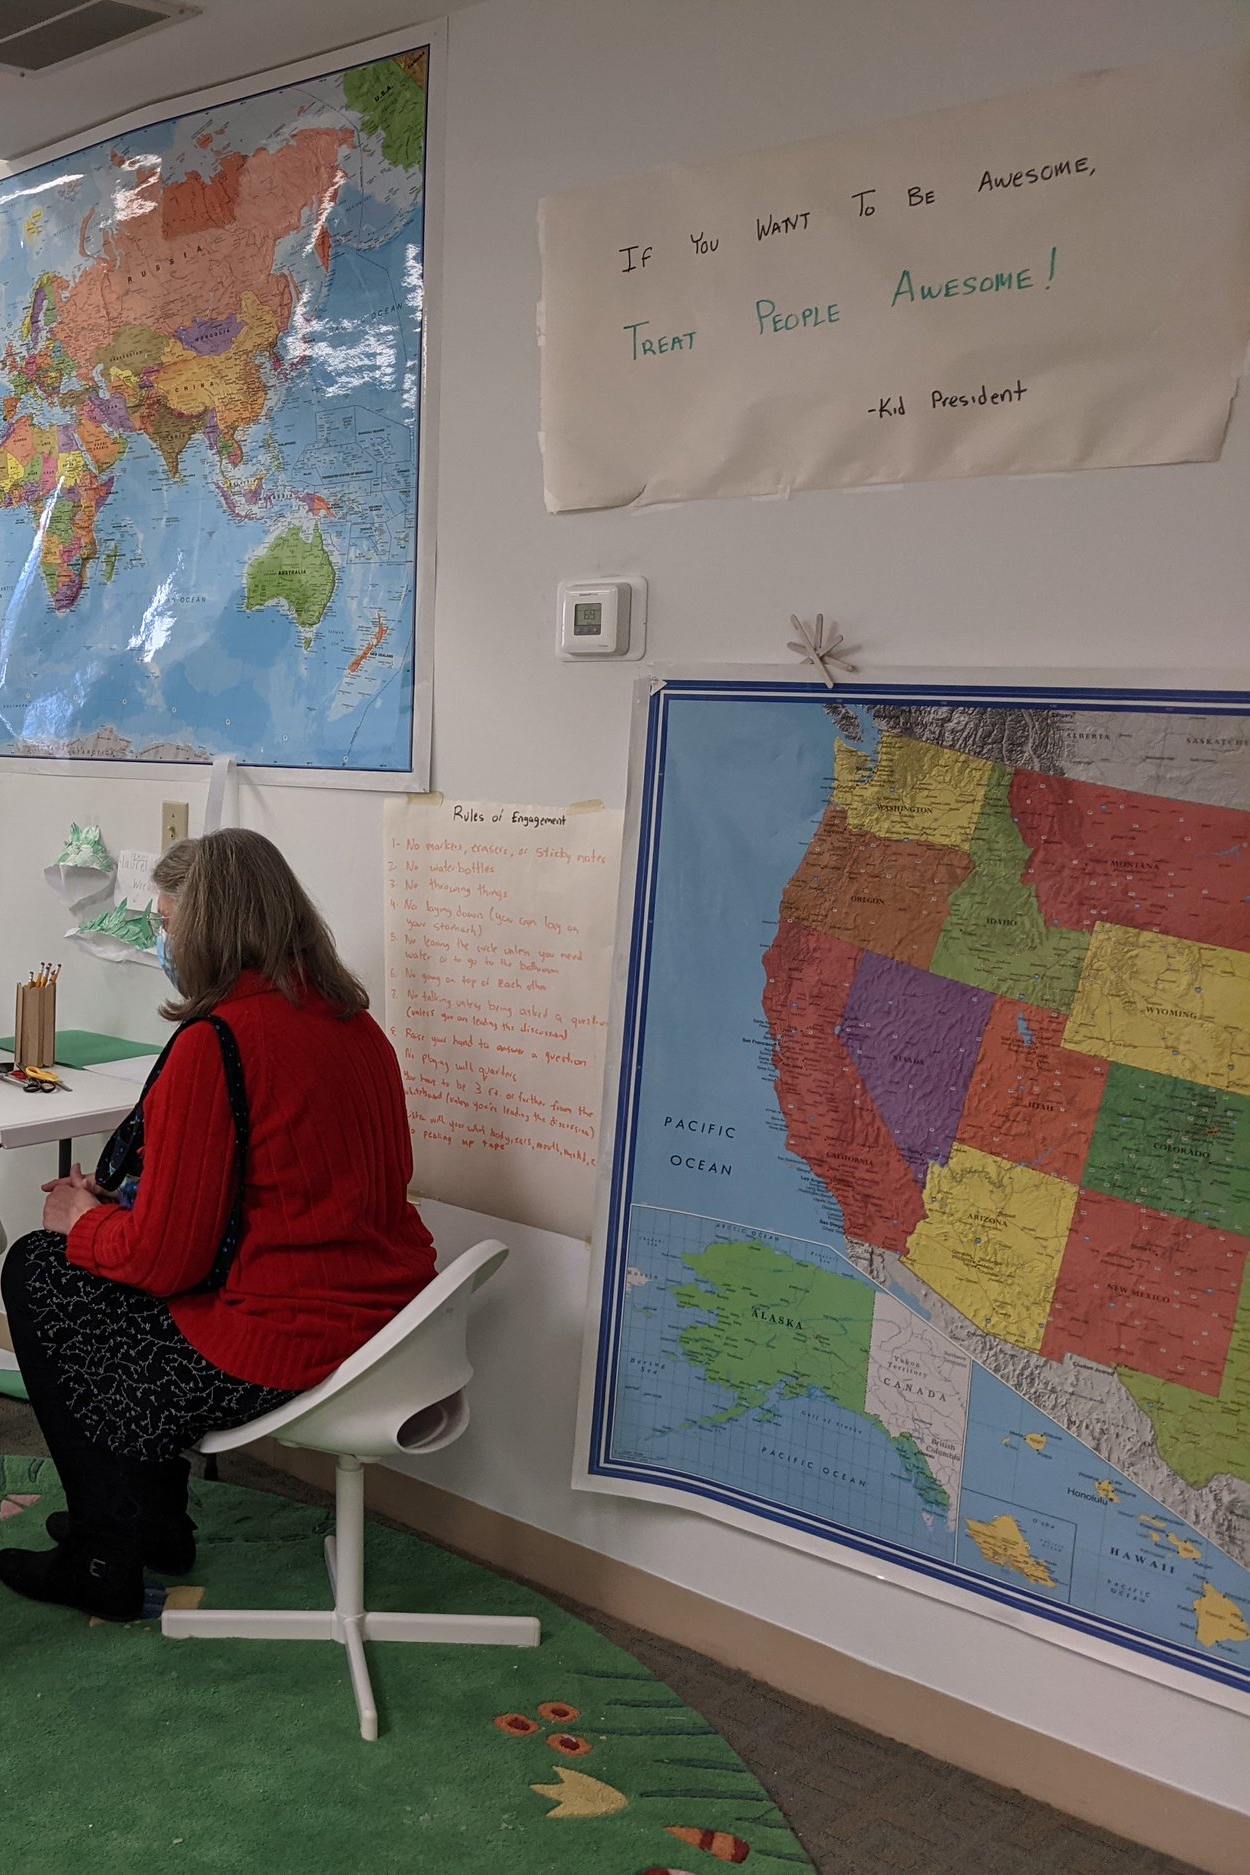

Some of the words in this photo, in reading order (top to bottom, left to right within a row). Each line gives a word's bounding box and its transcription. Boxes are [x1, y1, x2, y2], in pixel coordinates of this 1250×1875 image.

[907, 186, 937, 208] BE
[127, 245, 203, 283] RUSSIA
[371, 303, 403, 320] OCEAN
[623, 321, 698, 360] TREAT
[756, 299, 841, 335] PEOPLE
[174, 381, 214, 392] CHINA
[931, 380, 1028, 408] President
[180, 596, 207, 604] OCEAN
[583, 609, 596, 620] 69
[1066, 732, 1111, 741] ALBERTA
[454, 805, 485, 822] Rules
[491, 808, 504, 822] of
[511, 811, 566, 828] Engagement
[876, 804, 933, 814] WASHINGTON
[392, 838, 400, 848] 1.
[406, 838, 420, 851] No
[426, 839, 468, 855] markers,
[471, 844, 514, 857] erasers,
[518, 848, 528, 856] or
[577, 849, 607, 864] notes
[406, 861, 419, 872] No
[1110, 859, 1160, 871] MONTANA
[405, 880, 419, 890] No
[428, 878, 471, 897] throwing
[477, 883, 508, 901] things
[850, 896, 885, 905] OREGON
[404, 899, 418, 911] No
[426, 900, 452, 918] laying
[456, 904, 484, 919] down
[545, 916, 561, 935] lay
[406, 917, 426, 932] your
[986, 918, 1018, 927] IDAHO
[405, 934, 417, 945] No
[538, 950, 555, 964] you
[561, 950, 583, 961] need
[406, 949, 432, 961] water
[467, 958, 478, 969] go
[405, 967, 417, 978] No
[461, 975, 477, 988] top
[406, 1006, 435, 1018] (unless
[407, 989, 419, 1000] No
[519, 1004, 548, 1018] asked
[1145, 1006, 1199, 1020] WYOMING
[452, 1034, 474, 1048] hand
[478, 1038, 490, 1049] to
[496, 1044, 525, 1055] answer
[545, 1051, 587, 1067] question
[421, 1053, 450, 1074] playing
[892, 1054, 925, 1067] NEVADA
[456, 1080, 466, 1092] be
[474, 1081, 482, 1095] 3
[550, 1100, 572, 1114] from
[578, 1105, 594, 1118] the
[1027, 1102, 1054, 1112] UTAH
[664, 1116, 736, 1139] PACIFIC
[462, 1139, 475, 1148] up
[482, 1139, 505, 1150] tape
[1153, 1142, 1211, 1159] COLORADO
[670, 1154, 733, 1176] OCEAN
[826, 1151, 874, 1167] CALIFORNIA
[967, 1213, 1008, 1228] ARIZONA
[716, 1223, 746, 1234] ARCTIC
[751, 1231, 780, 1242] OCEAN
[1107, 1283, 1128, 1294] NEW
[1131, 1289, 1170, 1303] MEXICO
[751, 1309, 803, 1330] ALASKA
[630, 1357, 667, 1370] Bering
[894, 1355, 920, 1368] Yukon
[641, 1366, 658, 1375] Sea
[888, 1362, 928, 1379] Territory
[883, 1378, 946, 1402] CANADA
[801, 1410, 820, 1421] Gulf
[925, 1445, 961, 1461] Columbia
[931, 1438, 956, 1451] British
[761, 1446, 814, 1469] PACIFIC
[822, 1467, 866, 1487] OCEAN
[1067, 1487, 1109, 1506] Honolulu
[1110, 1546, 1175, 1574] HAWAII
[1107, 1579, 1151, 1597] PACIFIC
[1110, 1588, 1146, 1603] OCEAN
